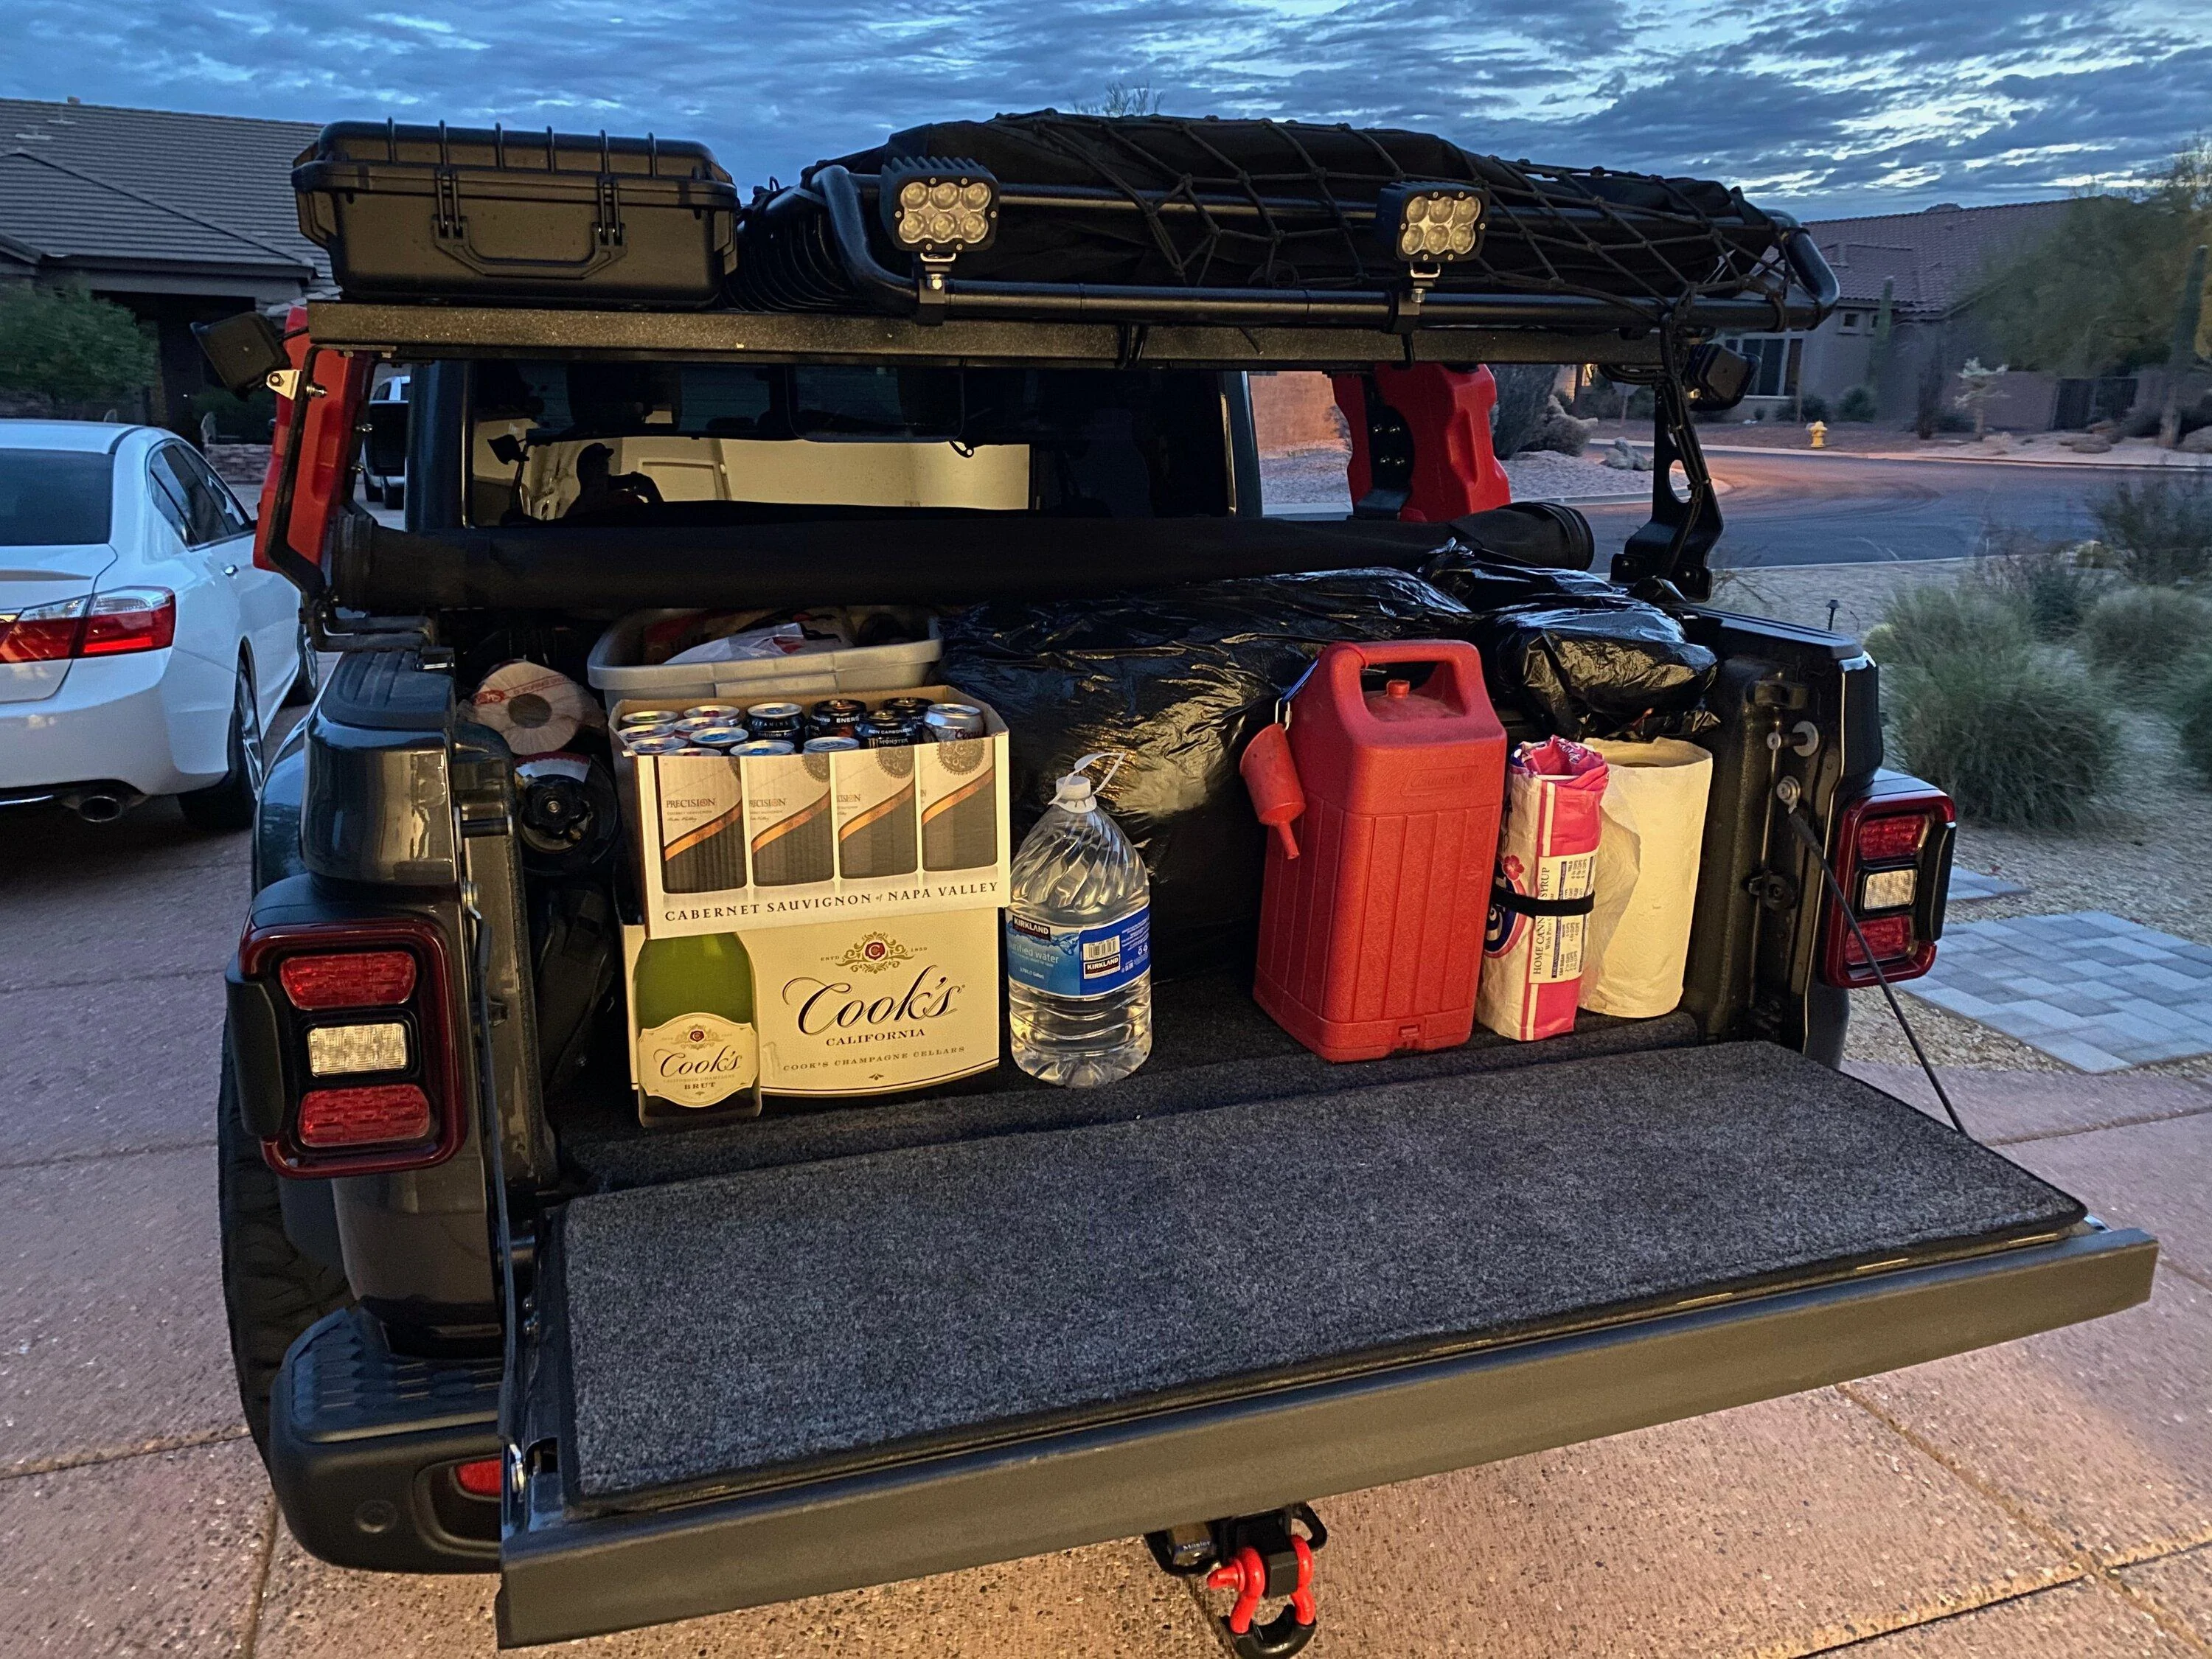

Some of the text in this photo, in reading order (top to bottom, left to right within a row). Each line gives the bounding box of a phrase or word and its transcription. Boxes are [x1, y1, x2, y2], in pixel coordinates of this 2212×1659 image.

[666, 798, 716, 808] PRECISION
[665, 882, 998, 922] CABERNET SAUVIGNON of NAPA VALLEY
[1014, 917, 1049, 935] KIRKLAND
[1533, 867, 1550, 974] HOME CANN SYRUP
[1035, 952, 1059, 964] water
[1087, 957, 1119, 970] KIRKLAND
[782, 964, 961, 1036] Cook's
[826, 1029, 925, 1046] CALIFORNIA
[653, 1044, 742, 1078] Cook's
[783, 1046, 965, 1071] COOK'S CHAMPAGNE CELLARS
[684, 1082, 717, 1090] BRUT
